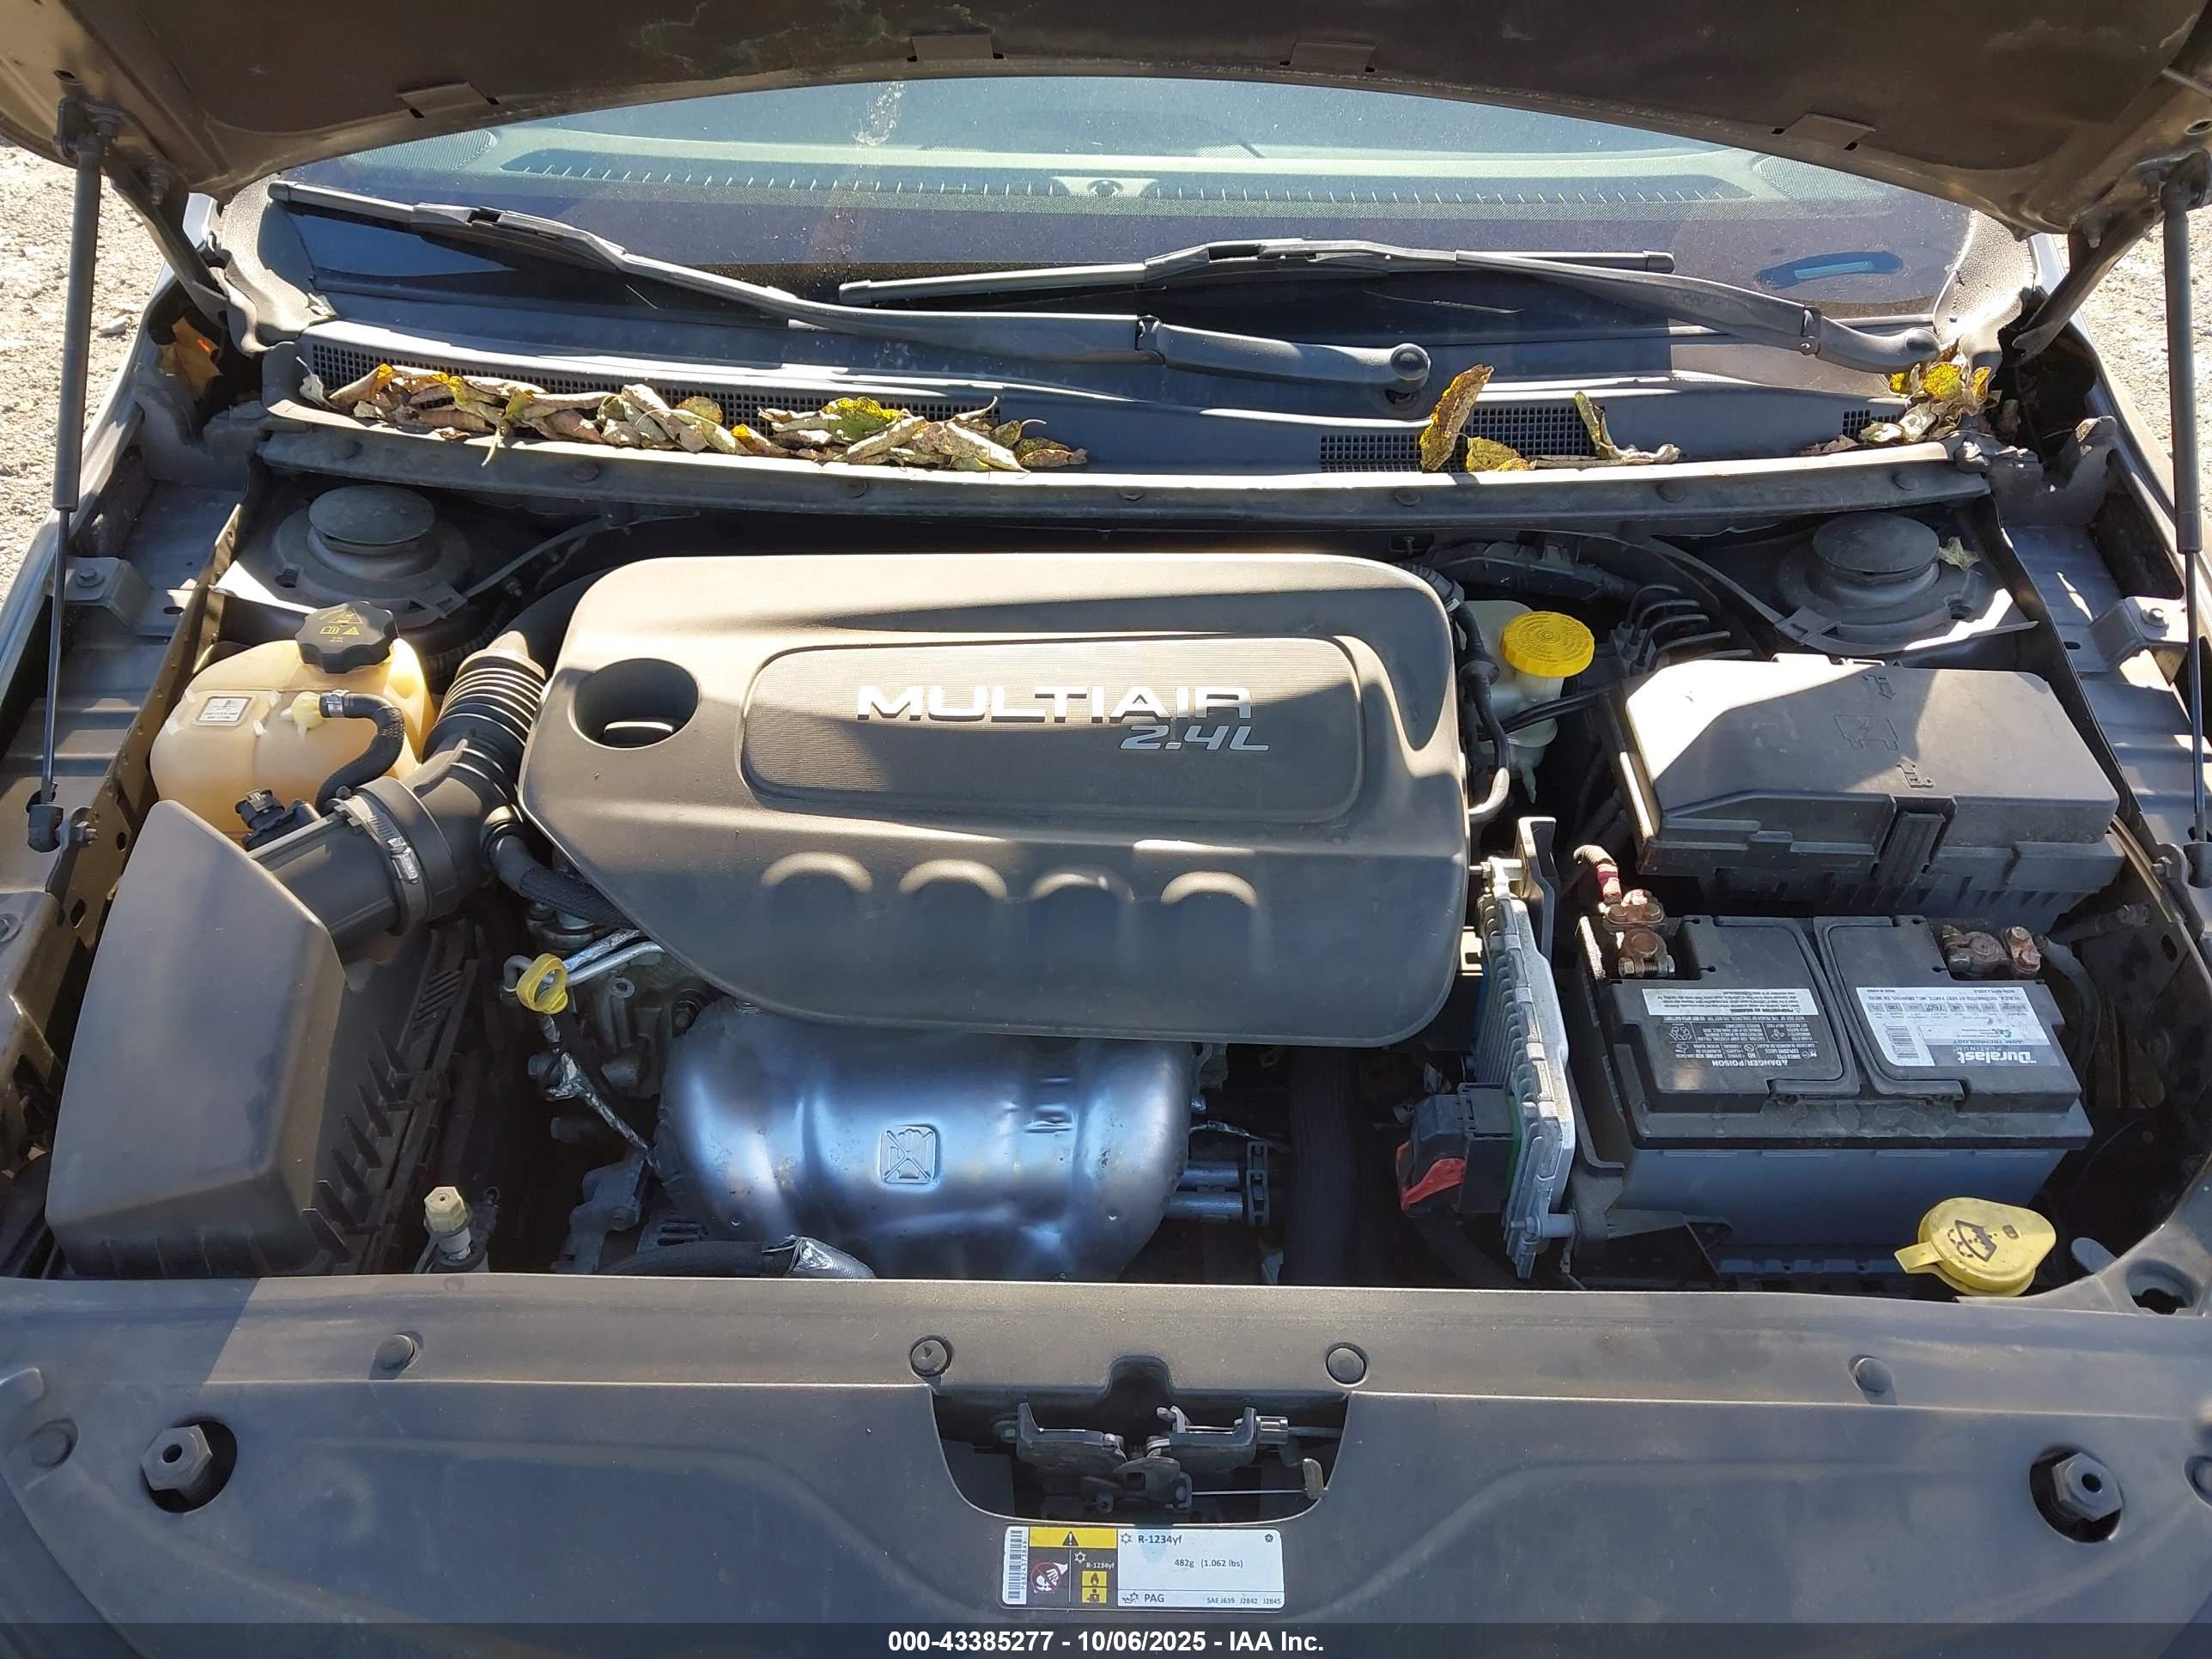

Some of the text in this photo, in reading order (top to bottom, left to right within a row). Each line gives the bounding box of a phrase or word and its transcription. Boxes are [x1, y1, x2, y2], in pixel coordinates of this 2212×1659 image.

[857, 686, 1254, 723] MULTIAIR
[1119, 725, 1269, 751] 2.4L
[1957, 1051, 2037, 1064] Duralast
[1138, 1534, 1182, 1546] R-1234yf
[1085, 1562, 1115, 1571] R-1234yf
[1174, 1559, 1243, 1569] 482g (1.062 lbs)
[1144, 1593, 1165, 1604] PAG
